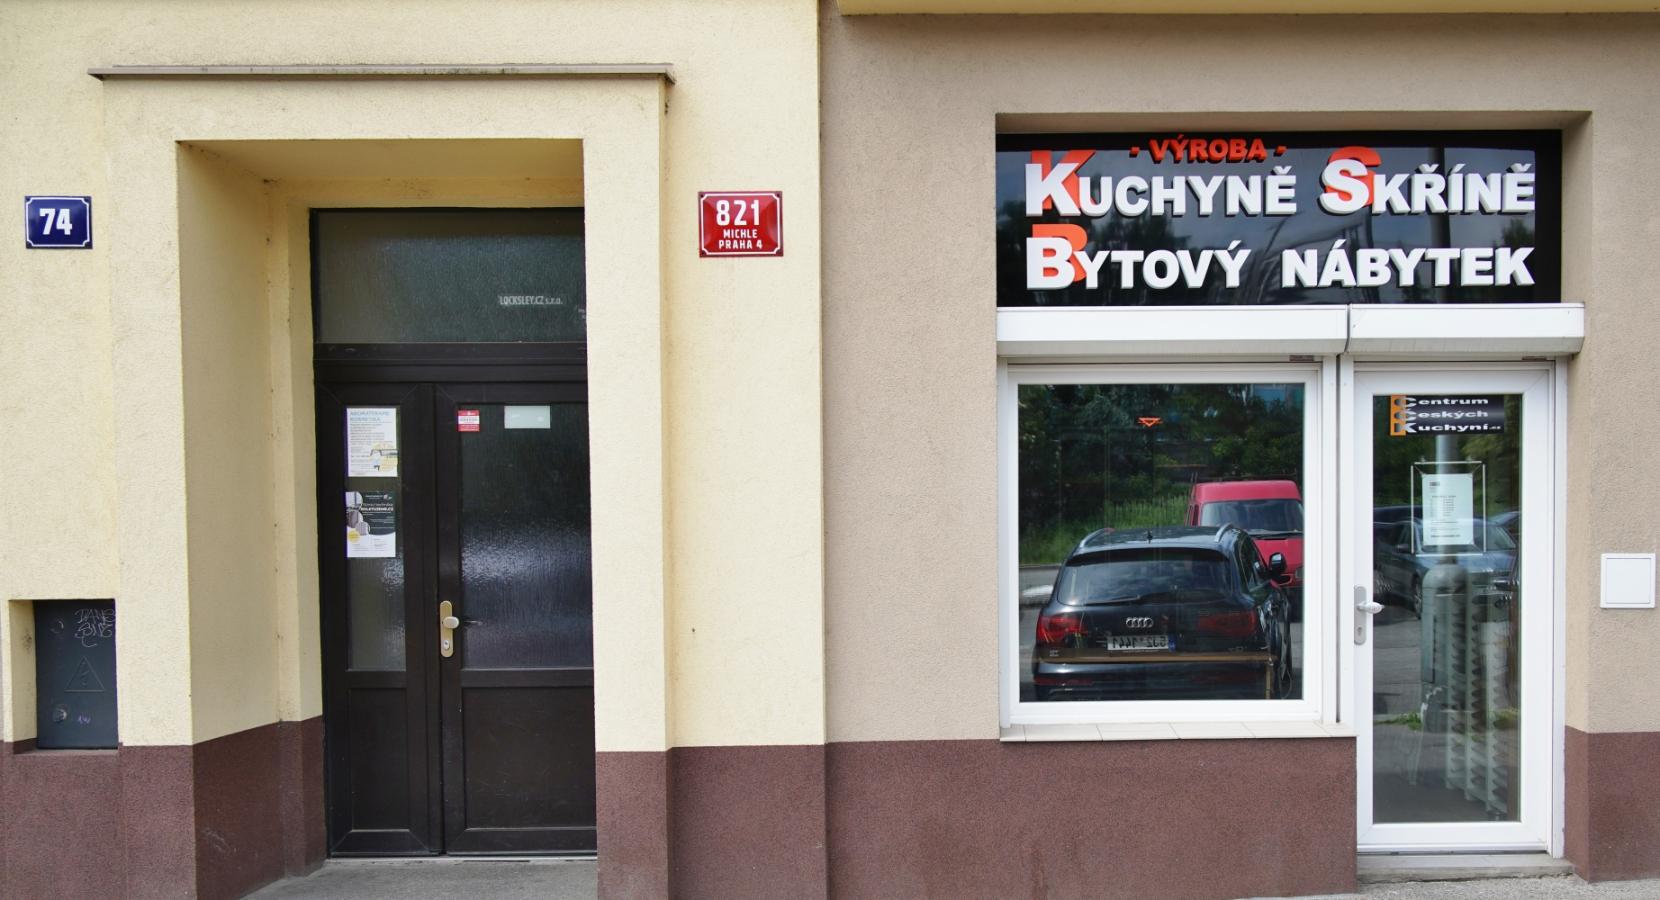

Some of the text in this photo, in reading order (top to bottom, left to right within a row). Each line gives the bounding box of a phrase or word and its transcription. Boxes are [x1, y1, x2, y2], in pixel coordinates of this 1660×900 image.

[1149, 134, 1268, 162] VÝROBA
[1025, 155, 1536, 217] KUCHYNĚ SKŘÍNĚ
[39, 208, 73, 235] 74
[716, 199, 760, 226] 821
[718, 239, 763, 249] PRAHA 4
[723, 229, 758, 239] MICHLE
[1026, 234, 1535, 290] BYTOVÝ NÁBYTEK
[499, 295, 545, 305] LOCKSLEY.CZ
[1394, 397, 1489, 408] Centrum
[1394, 408, 1489, 421] Českých
